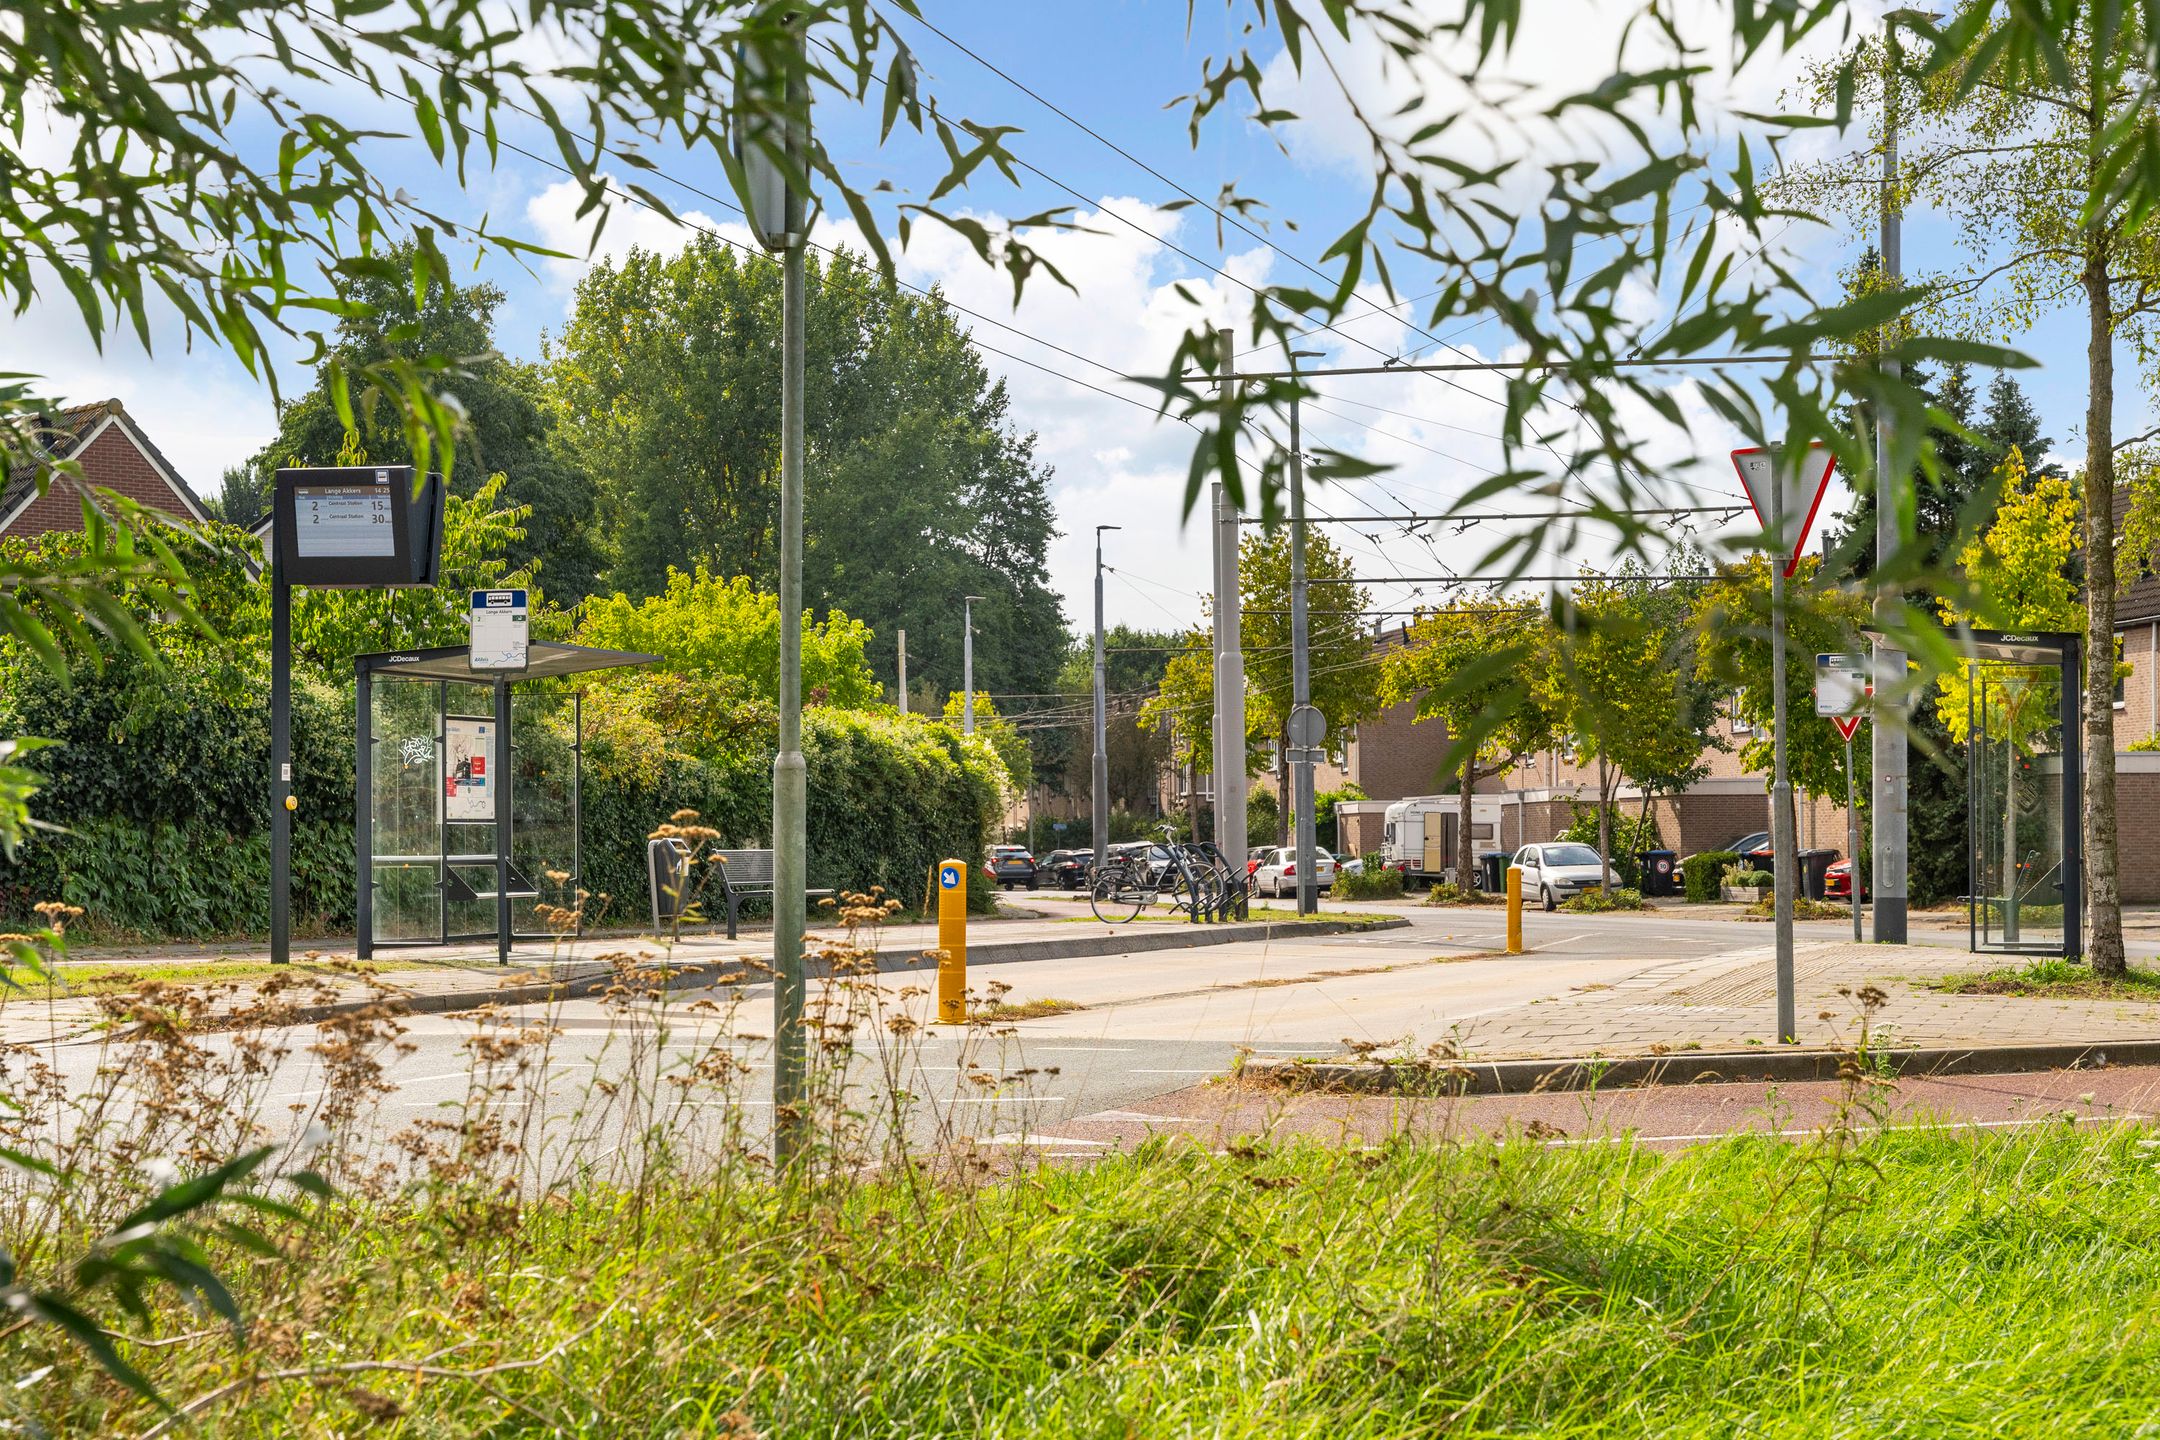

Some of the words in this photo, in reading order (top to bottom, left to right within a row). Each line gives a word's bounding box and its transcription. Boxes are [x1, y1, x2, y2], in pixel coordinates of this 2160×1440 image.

[312, 501, 319, 511] 2
[371, 501, 384, 511] 15
[313, 514, 320, 524] 2
[372, 514, 385, 524] 30
[2000, 634, 2039, 642] JCDecaux
